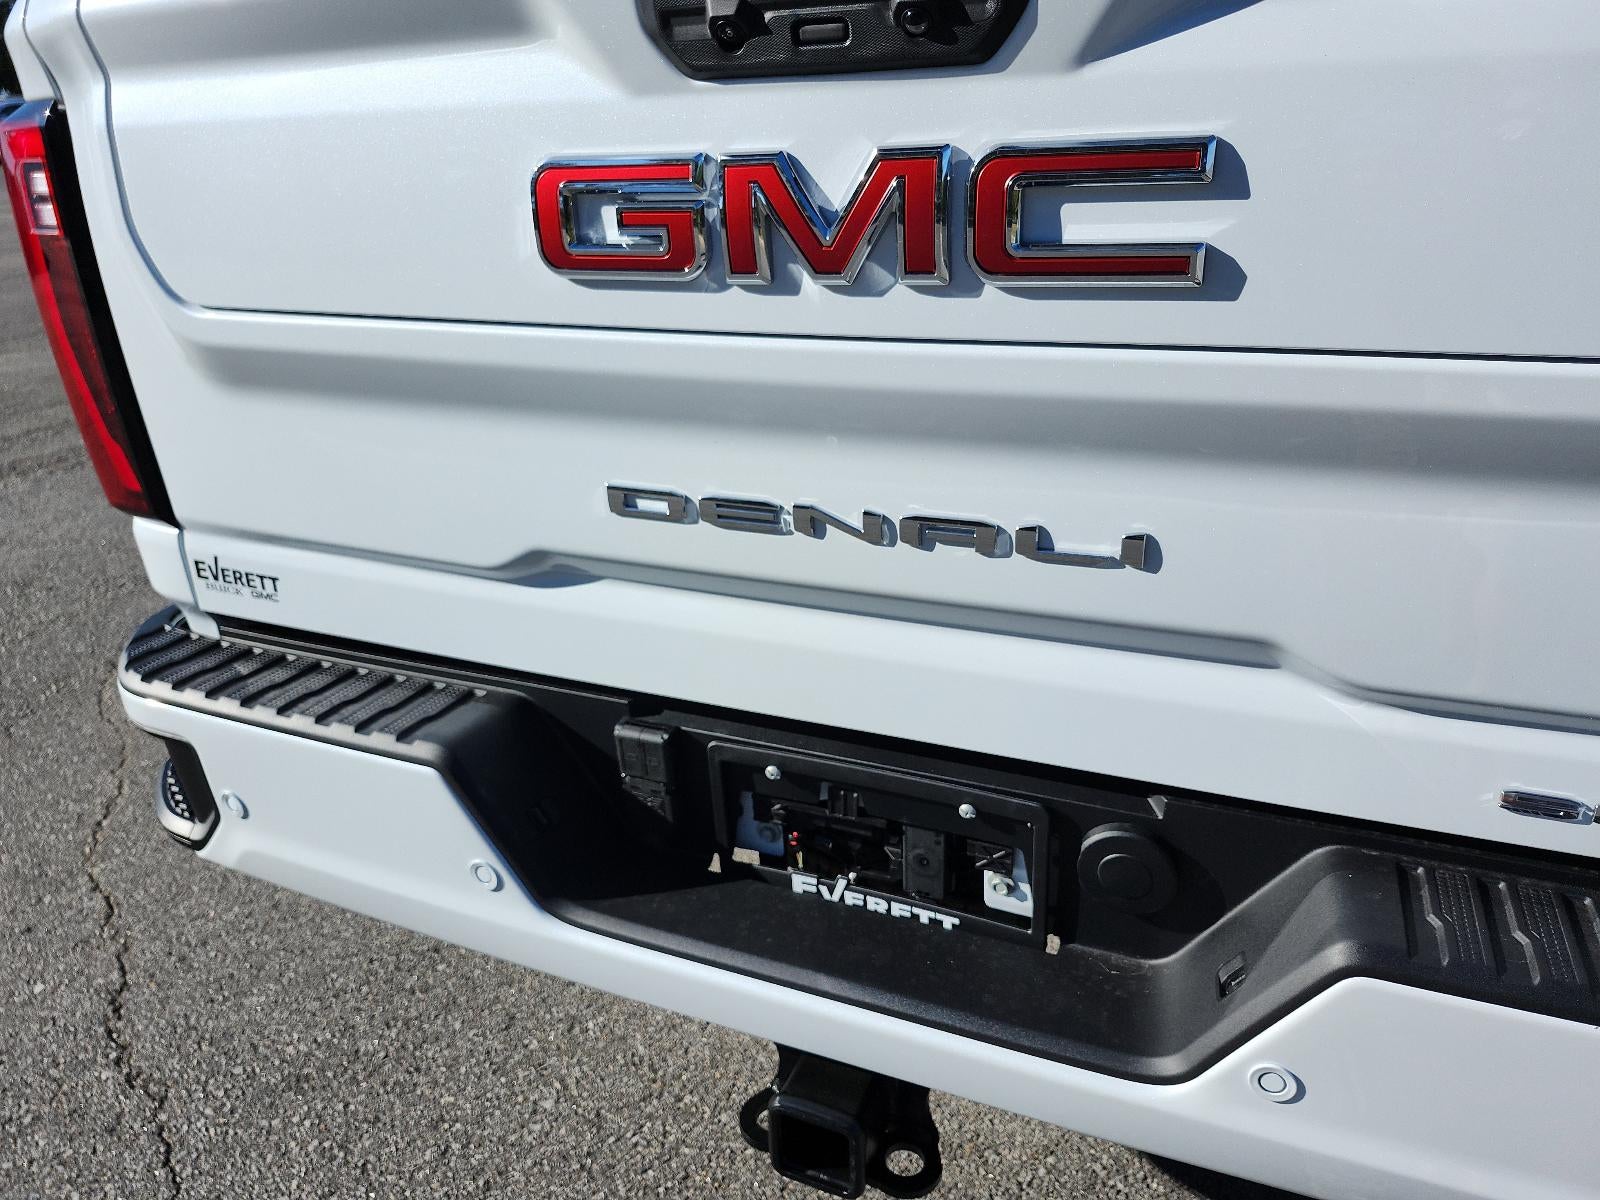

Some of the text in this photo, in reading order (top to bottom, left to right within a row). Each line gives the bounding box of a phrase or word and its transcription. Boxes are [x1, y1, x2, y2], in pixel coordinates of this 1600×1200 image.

[530, 134, 1218, 287] GMC
[606, 483, 1148, 571] DENALI
[193, 555, 280, 593] EVERETT
